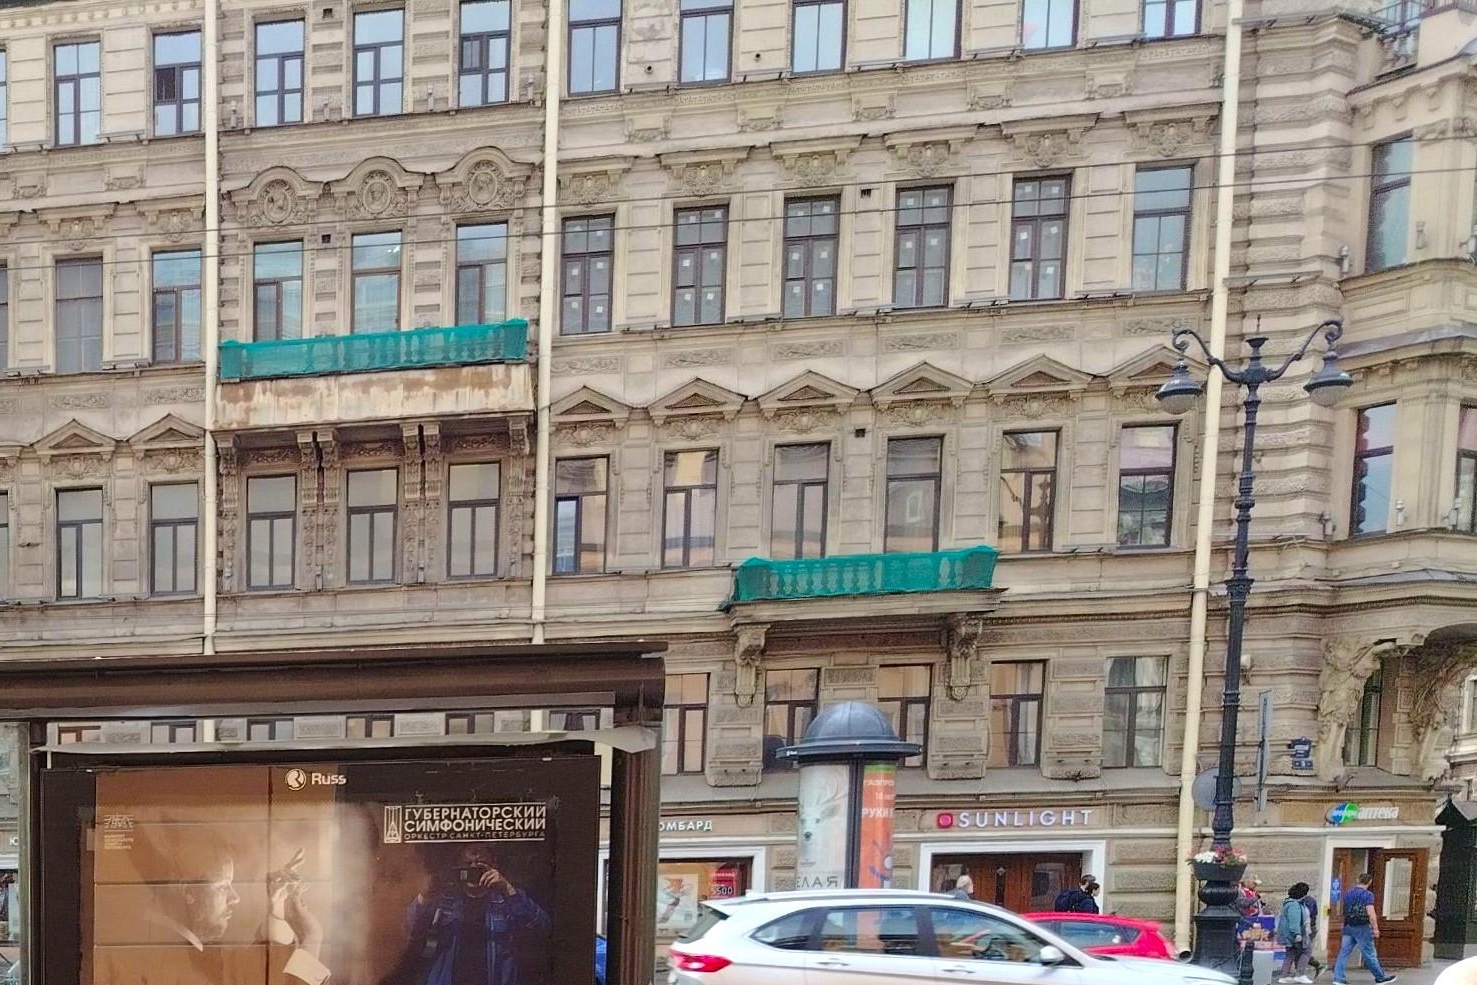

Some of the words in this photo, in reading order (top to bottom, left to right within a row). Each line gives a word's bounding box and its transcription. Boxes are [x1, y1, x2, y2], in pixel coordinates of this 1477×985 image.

[311, 772, 347, 785] Russ
[404, 805, 547, 820] ГУБЕРНАТОРСКИЙ
[958, 809, 1093, 828] SUNLIGHT
[404, 818, 546, 833] СИМФОНИЧЕСКИЙ
[404, 832, 447, 840] ОРКЕСТР
[450, 831, 546, 840] САНКТ-ПЕТЕРБУРГА
